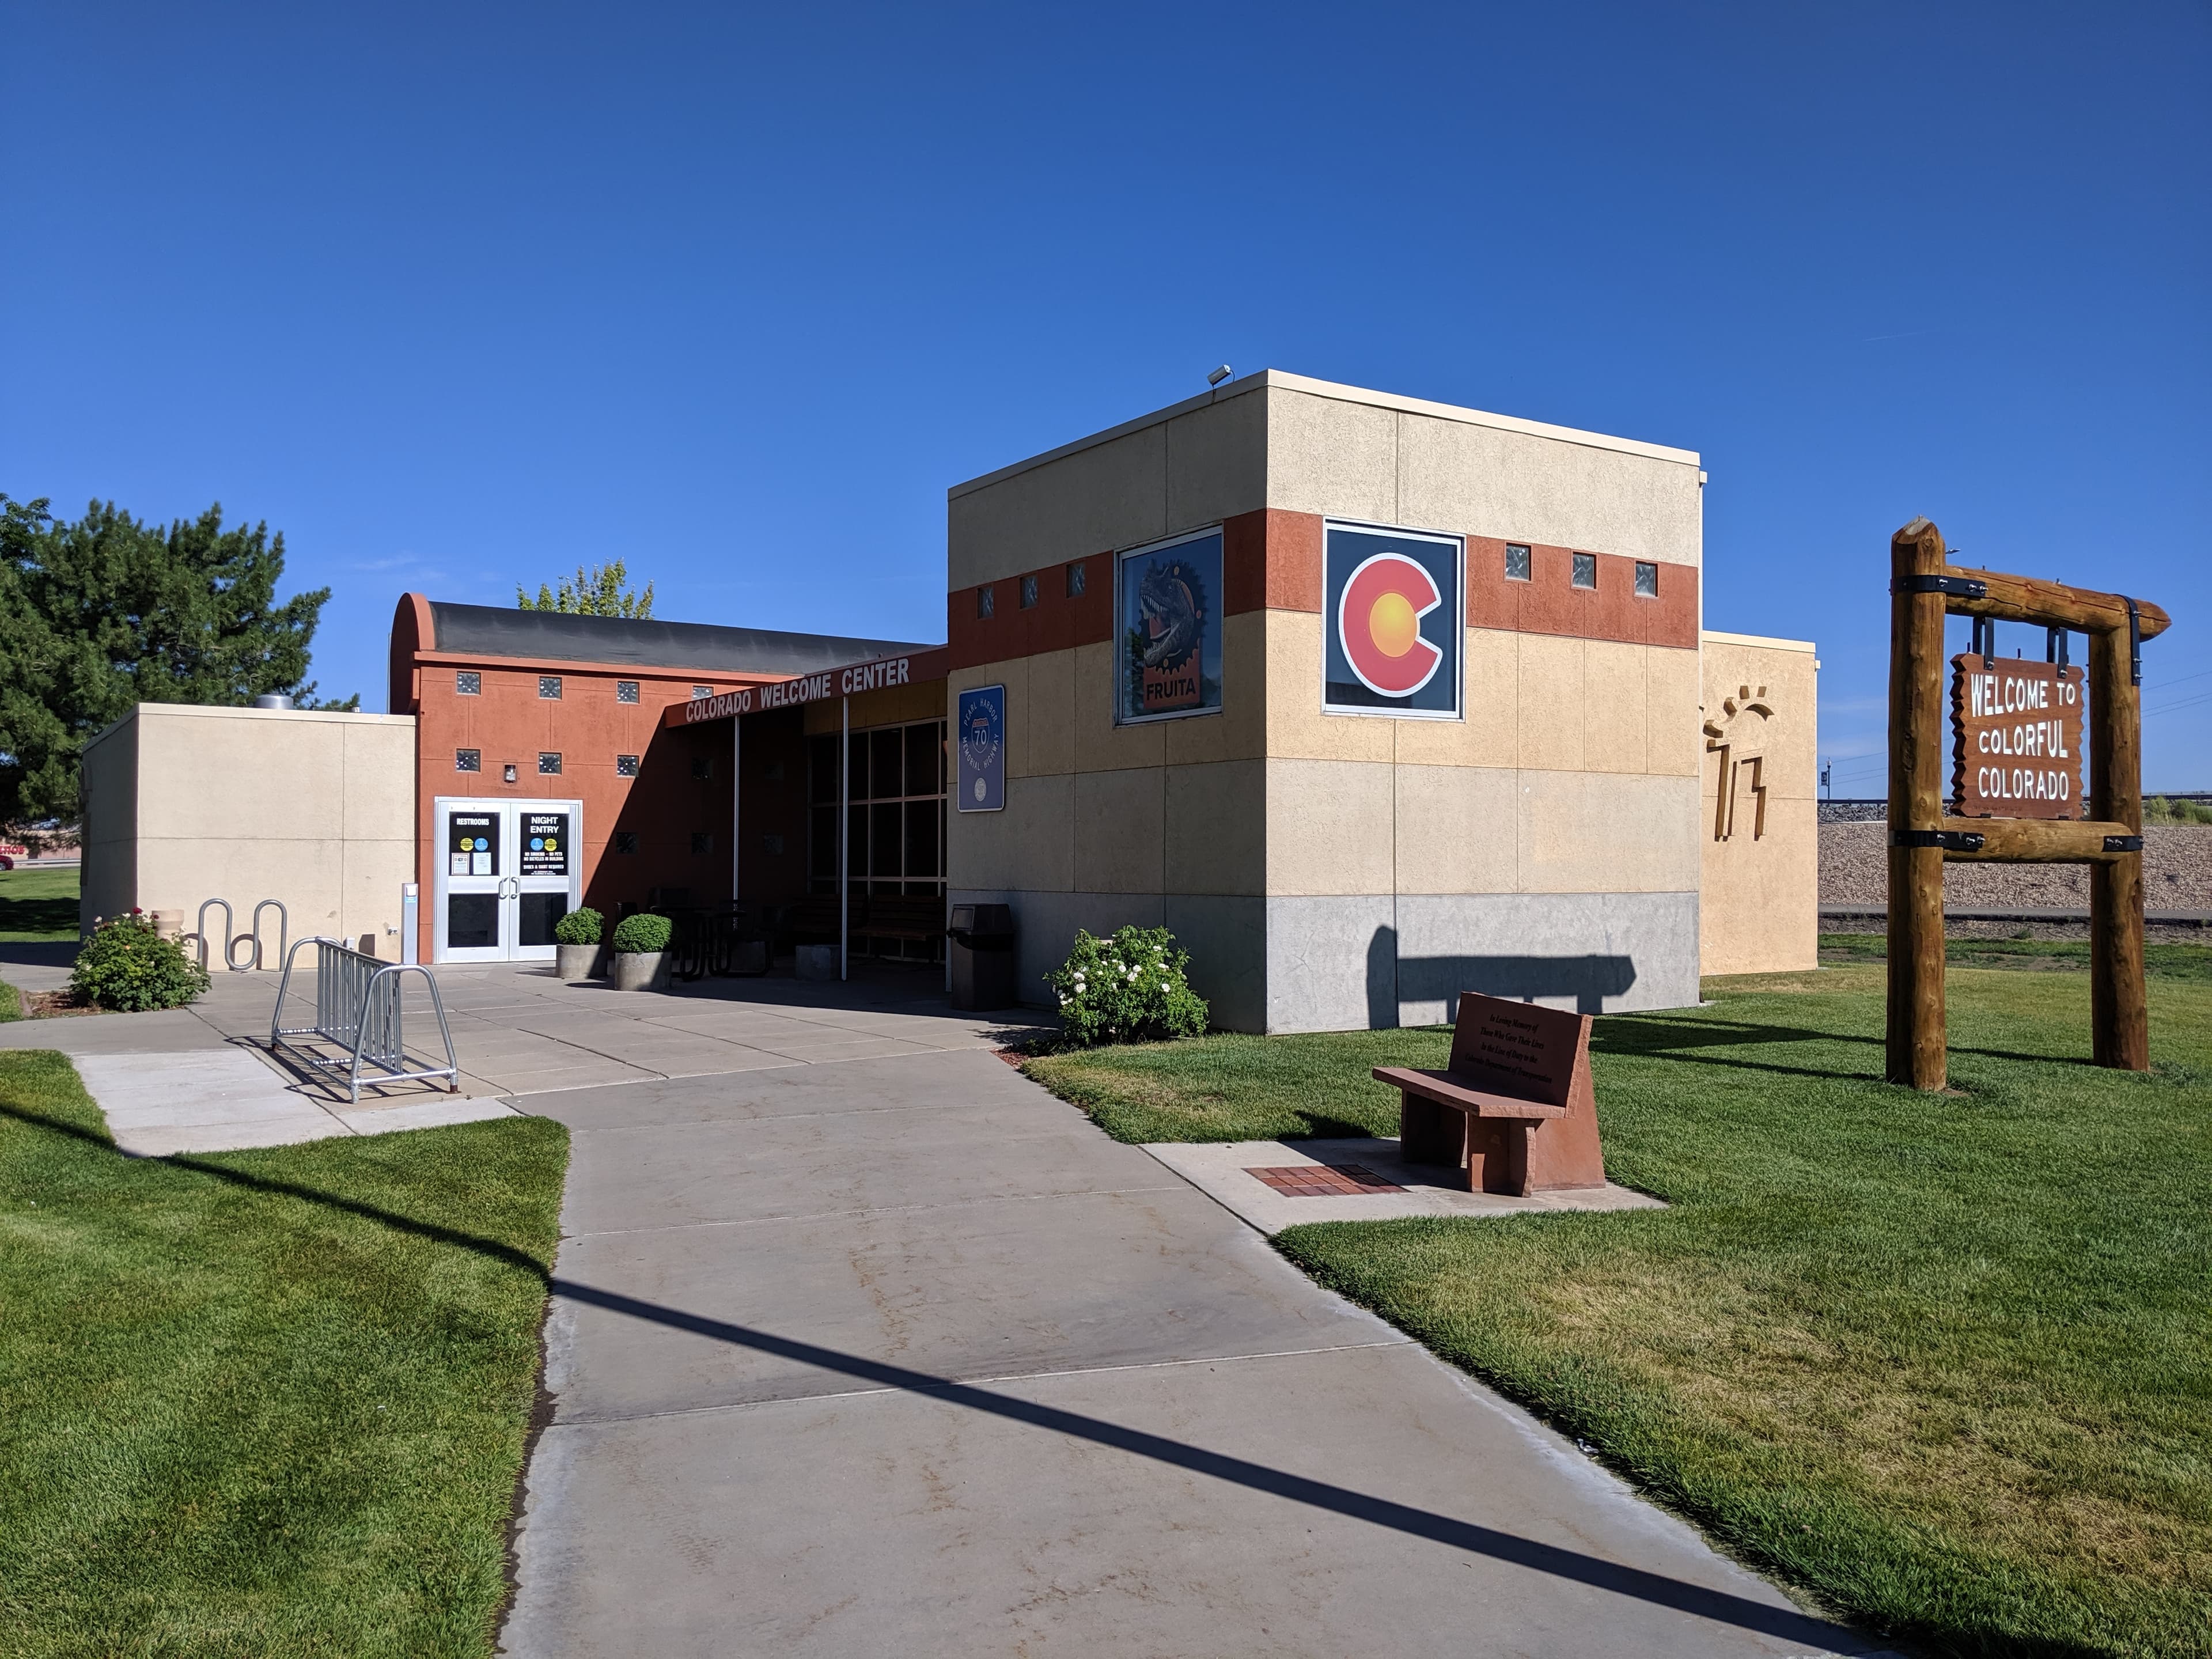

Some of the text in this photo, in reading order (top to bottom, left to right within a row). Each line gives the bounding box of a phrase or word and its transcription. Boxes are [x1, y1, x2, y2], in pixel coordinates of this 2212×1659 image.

[686, 658, 910, 722] COLORADO WELCOME CENTER
[1146, 677, 1196, 700] FRUITA
[1971, 673, 2076, 718] WELCOME TO
[964, 698, 998, 726] PEARL HARBOR
[975, 729, 987, 746] 70
[1979, 719, 2069, 758] COLORFUL
[963, 733, 999, 771] MEMORIAL HIGHWAY
[1978, 767, 2069, 801] COLORADO
[530, 825, 559, 834] ENTRY
[531, 816, 558, 824] NIGHT
[1490, 1014, 1539, 1033] In Loving Memory of
[1480, 1027, 1544, 1050] Those Who Gave Their Lives
[1495, 1046, 1505, 1055] Line
[1506, 1050, 1513, 1058] of
[1512, 1050, 1523, 1062] Duty
[1529, 1055, 1537, 1063] the
